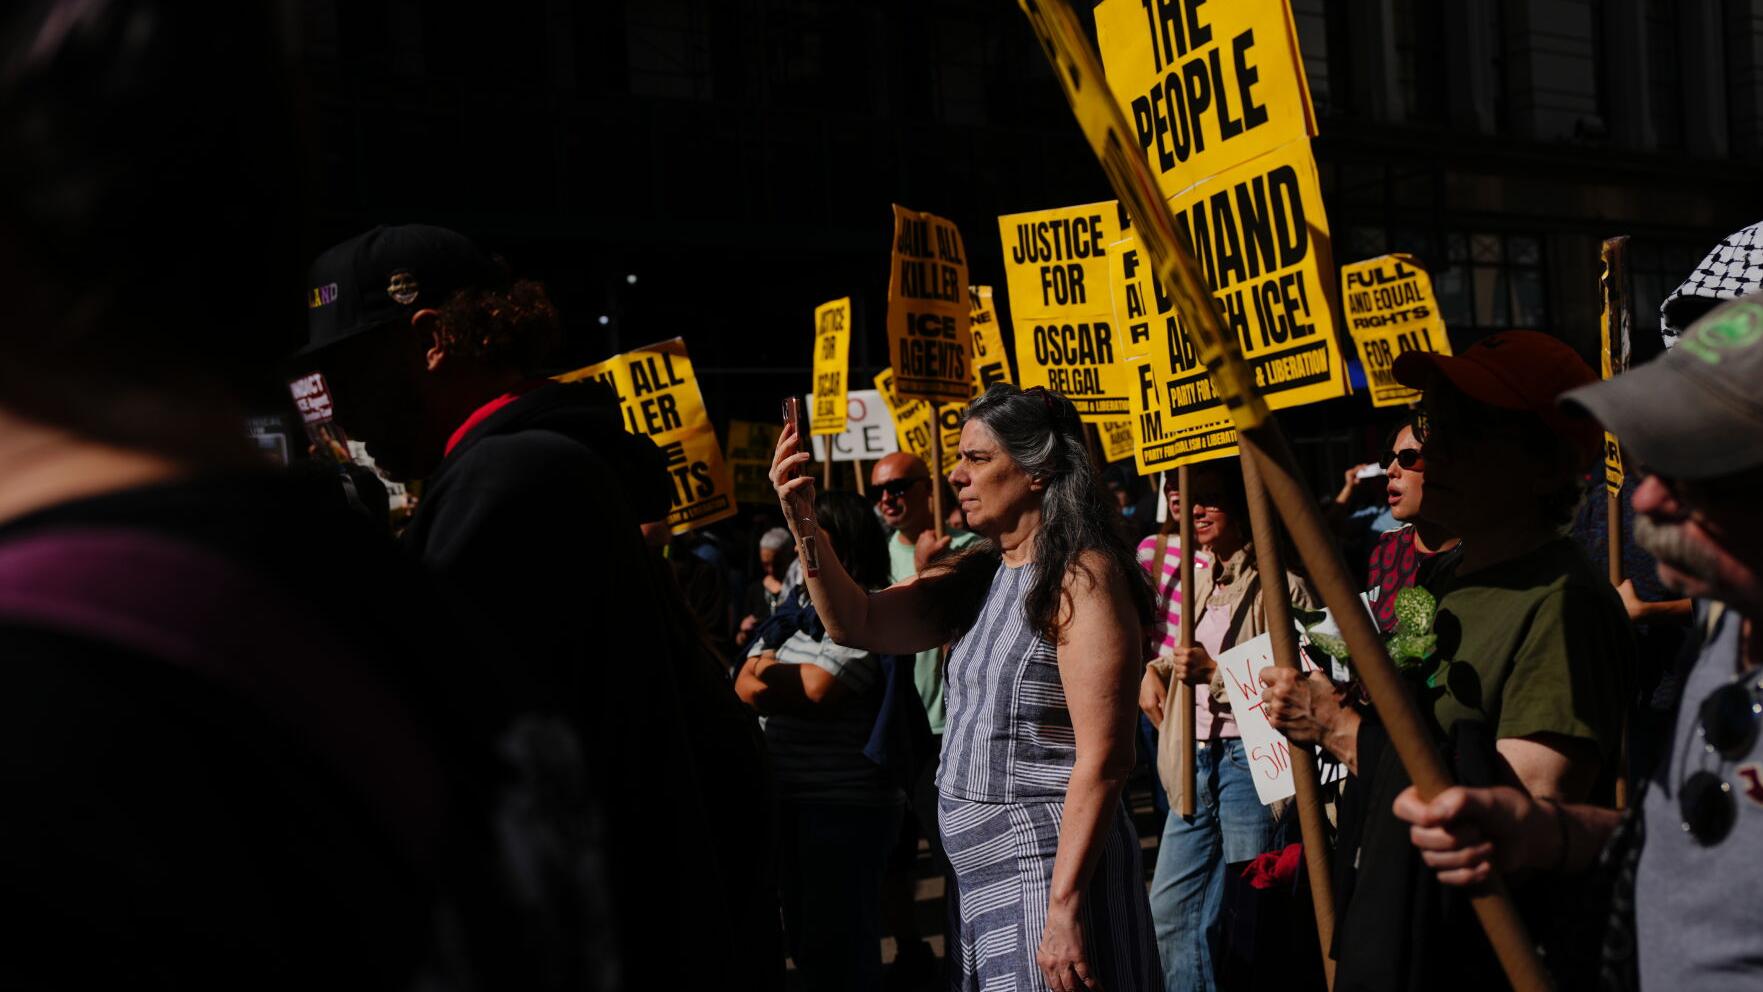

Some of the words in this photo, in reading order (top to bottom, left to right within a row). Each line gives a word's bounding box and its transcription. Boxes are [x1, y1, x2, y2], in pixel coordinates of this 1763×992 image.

[1142, 0, 1213, 74] THE
[1131, 28, 1269, 174] PEOPLE
[897, 216, 934, 258] JAIL
[936, 224, 963, 266] ALL
[1012, 214, 1106, 264] JUSTICE
[900, 260, 960, 304] KILLER
[1040, 263, 1086, 306] FOR
[1347, 263, 1416, 290] FULL
[1350, 292, 1373, 315] AND
[1374, 280, 1425, 311] EQUAL
[907, 312, 957, 340] ICE
[1253, 271, 1316, 347] ICE!
[1353, 305, 1430, 330] RIGHTS
[899, 337, 965, 380] AGENTS
[1033, 322, 1114, 366] OSCAR
[1363, 339, 1393, 369] FOR
[629, 351, 685, 397] ALL
[1048, 367, 1105, 395] BELGAL
[1170, 382, 1196, 409] PARTY
[1196, 378, 1212, 402] FOR
[1255, 366, 1266, 388] &
[1265, 348, 1329, 385] LIBERATION
